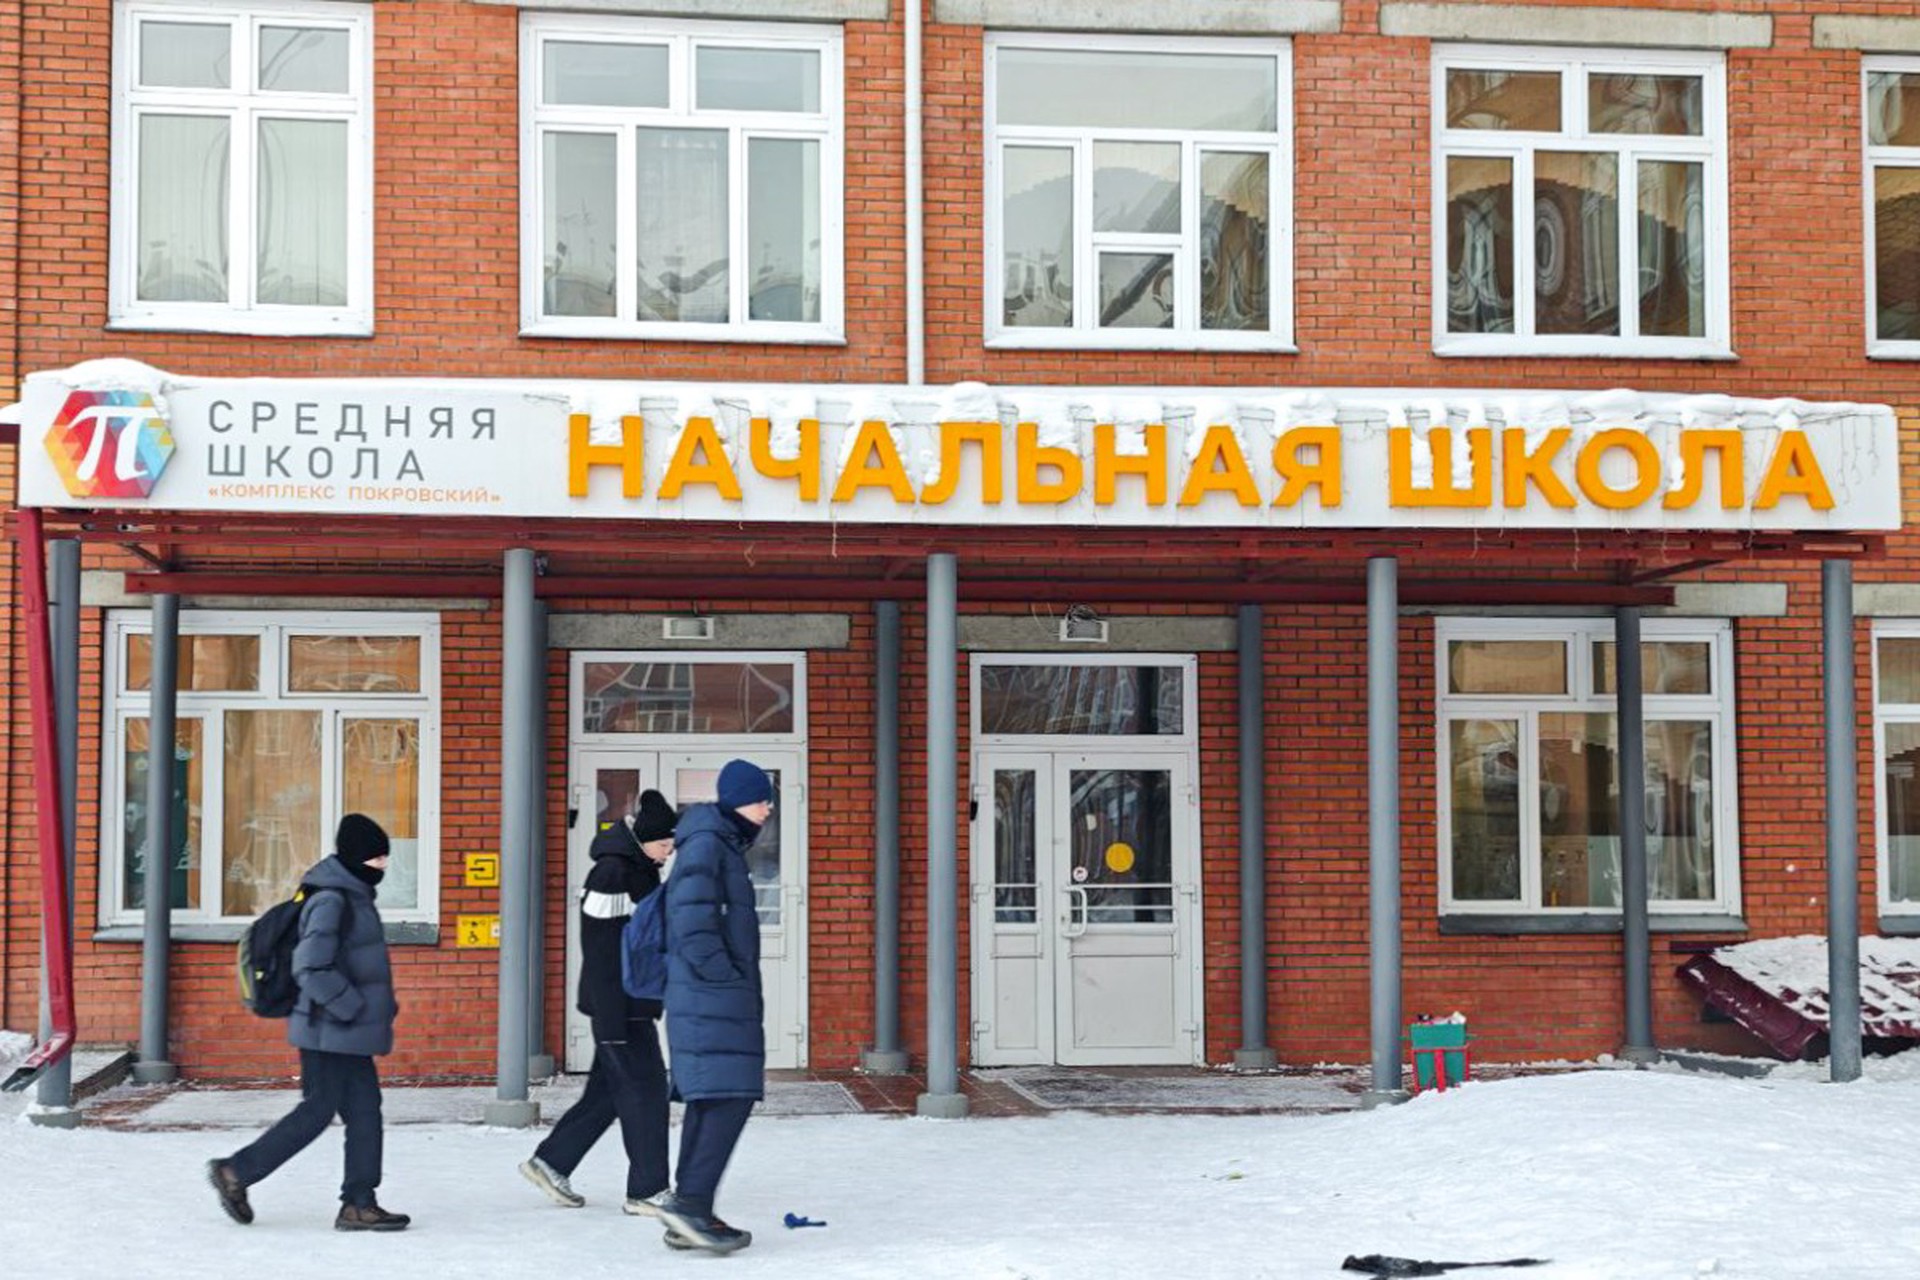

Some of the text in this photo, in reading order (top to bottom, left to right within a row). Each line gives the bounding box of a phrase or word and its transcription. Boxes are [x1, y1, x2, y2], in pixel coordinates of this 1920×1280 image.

[208, 400, 496, 442] СРЕДНЯЯ
[207, 444, 425, 481] ШКОЛА
[568, 413, 1836, 510] НАЧАЛЬНАЯ ШКОЛА
[208, 484, 336, 499] «КОМПЛЕКС
